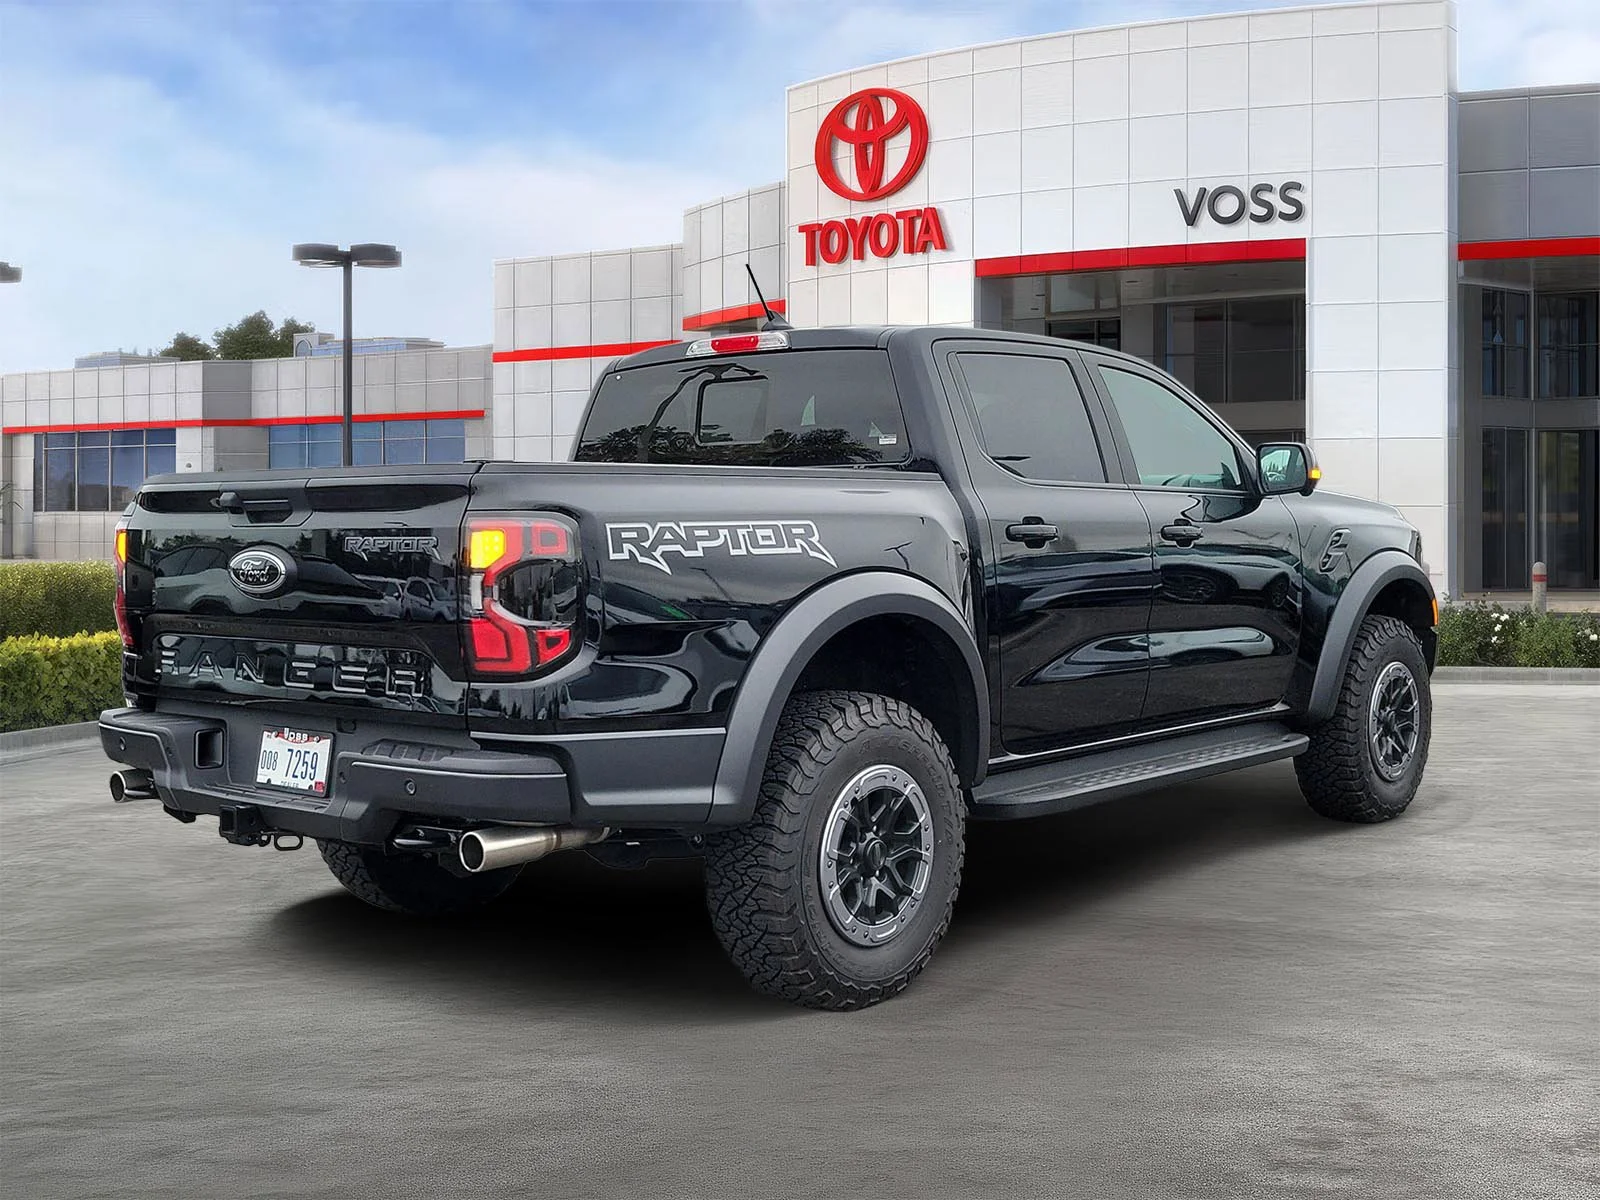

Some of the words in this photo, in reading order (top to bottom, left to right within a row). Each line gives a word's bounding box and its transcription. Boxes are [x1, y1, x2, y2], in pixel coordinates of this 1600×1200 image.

[1174, 181, 1306, 228] VOSS
[798, 206, 949, 267] TOYOTA
[344, 536, 441, 562] RAPTOR
[605, 519, 838, 576] RAPTOR
[240, 559, 270, 582] Ford
[260, 749, 279, 771] 008
[285, 748, 319, 781] 7259
